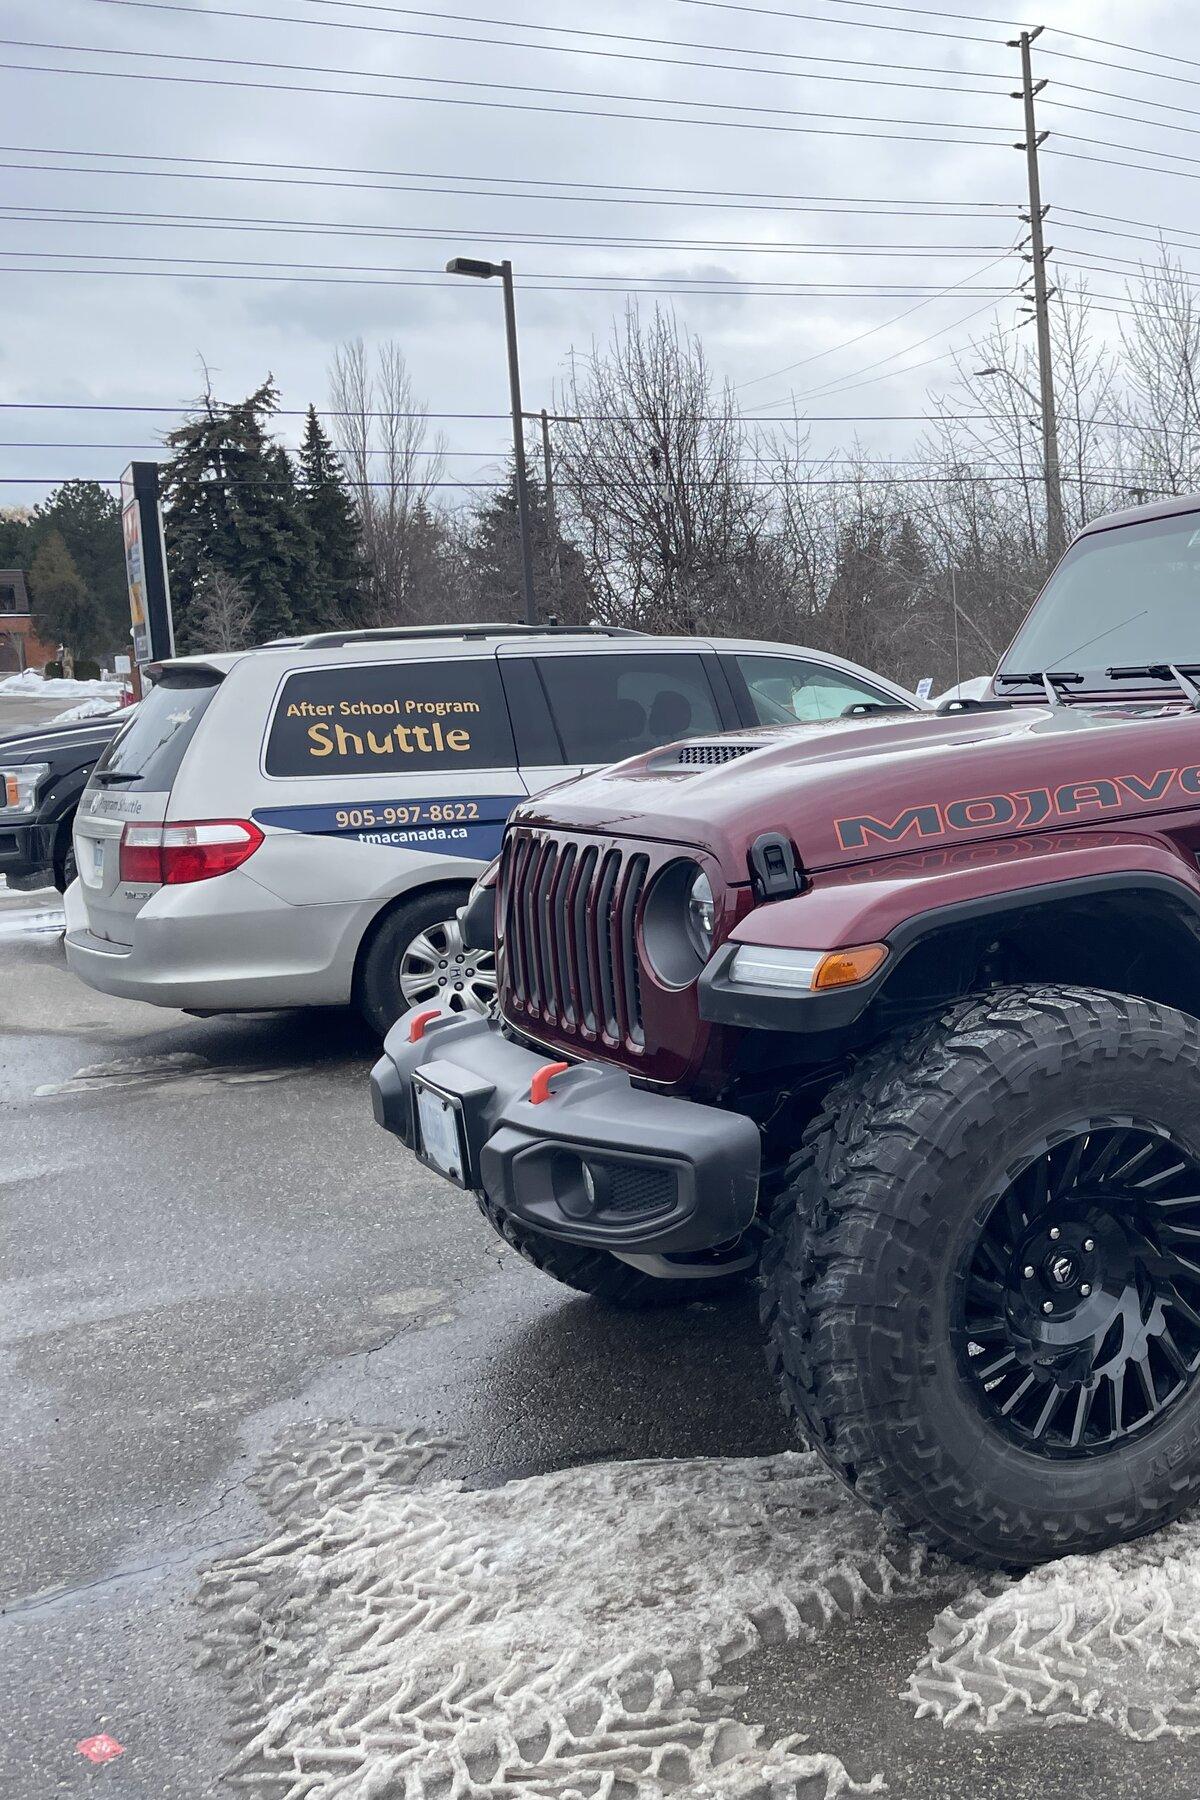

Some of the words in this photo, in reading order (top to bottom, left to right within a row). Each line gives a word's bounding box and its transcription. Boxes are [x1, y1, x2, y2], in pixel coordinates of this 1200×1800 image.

[287, 699, 335, 717] After
[340, 700, 400, 716] School
[405, 700, 480, 716] Program
[307, 722, 472, 757] Shuttle
[335, 802, 480, 828] 905-997-8622
[358, 827, 468, 844] tmacanada.ca
